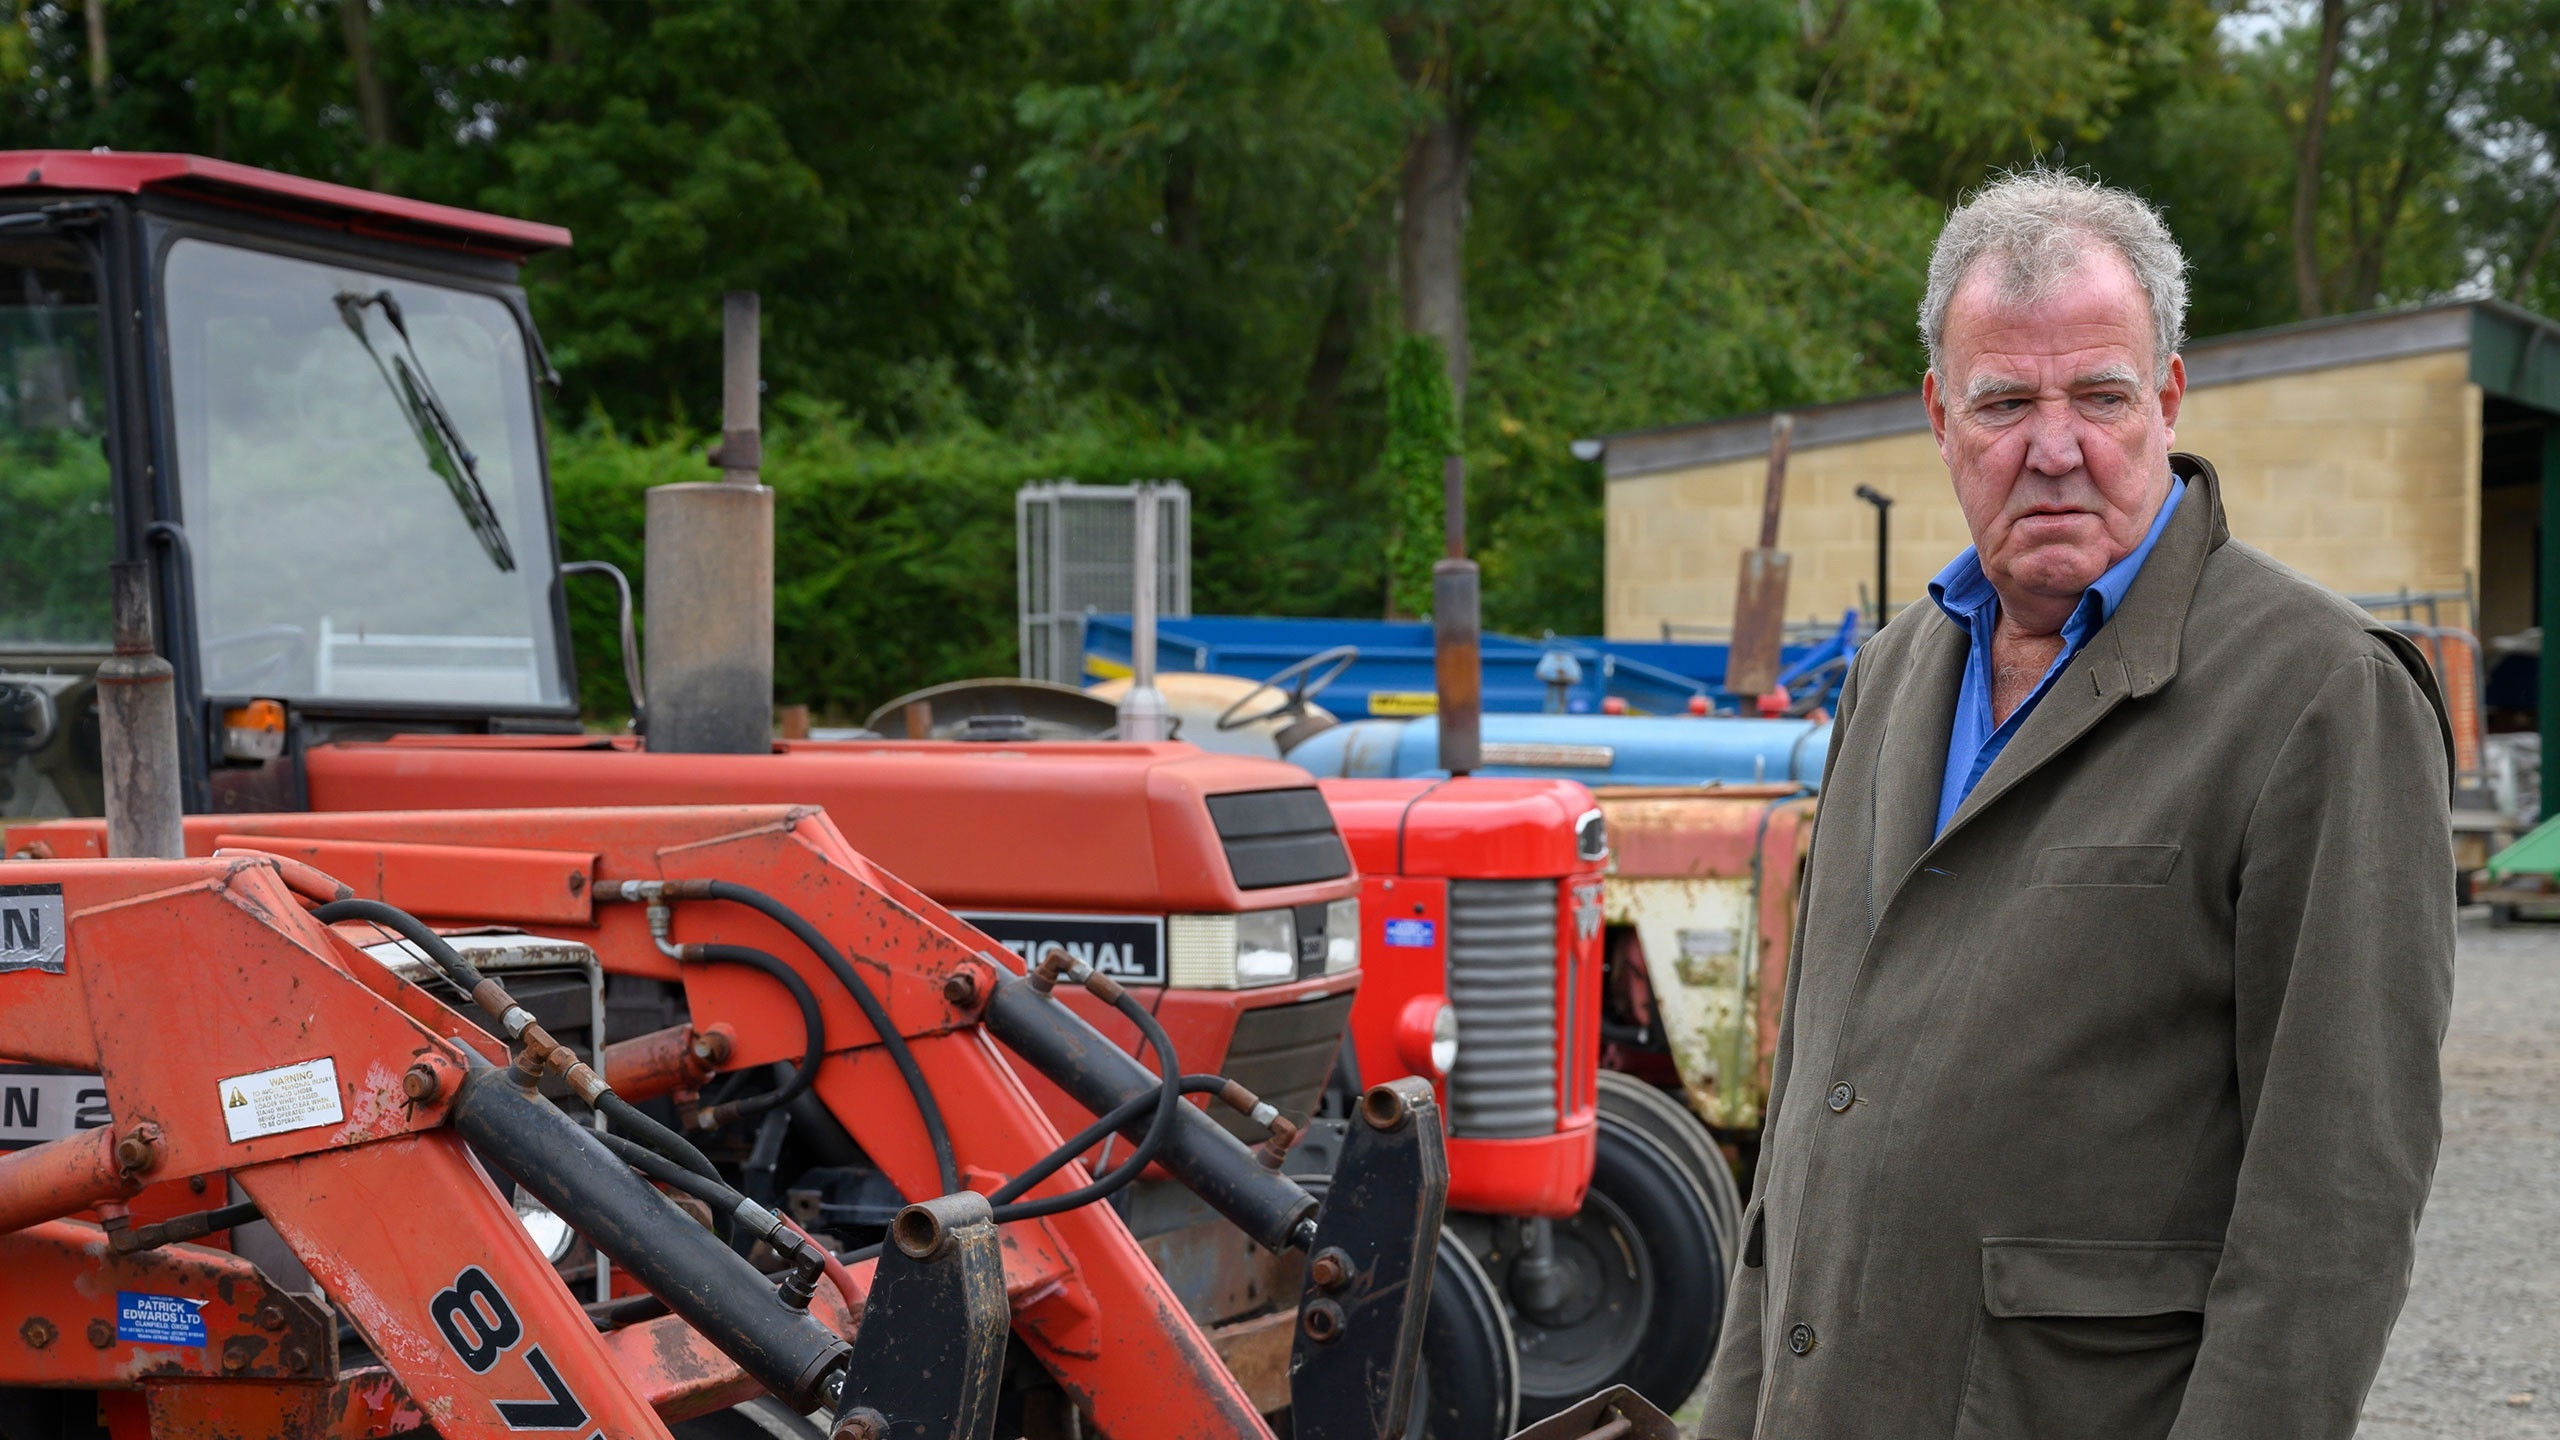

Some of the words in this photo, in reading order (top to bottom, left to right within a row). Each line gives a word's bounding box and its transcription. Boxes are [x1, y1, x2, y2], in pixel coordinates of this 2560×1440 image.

[3, 907, 41, 951] N
[269, 1070, 314, 1086] WARNING
[3, 1087, 39, 1128] N
[123, 1308, 177, 1323] EDWARDS
[180, 1313, 201, 1324] LTD
[137, 1299, 185, 1313] PATRICK
[428, 1264, 609, 1440] 87
